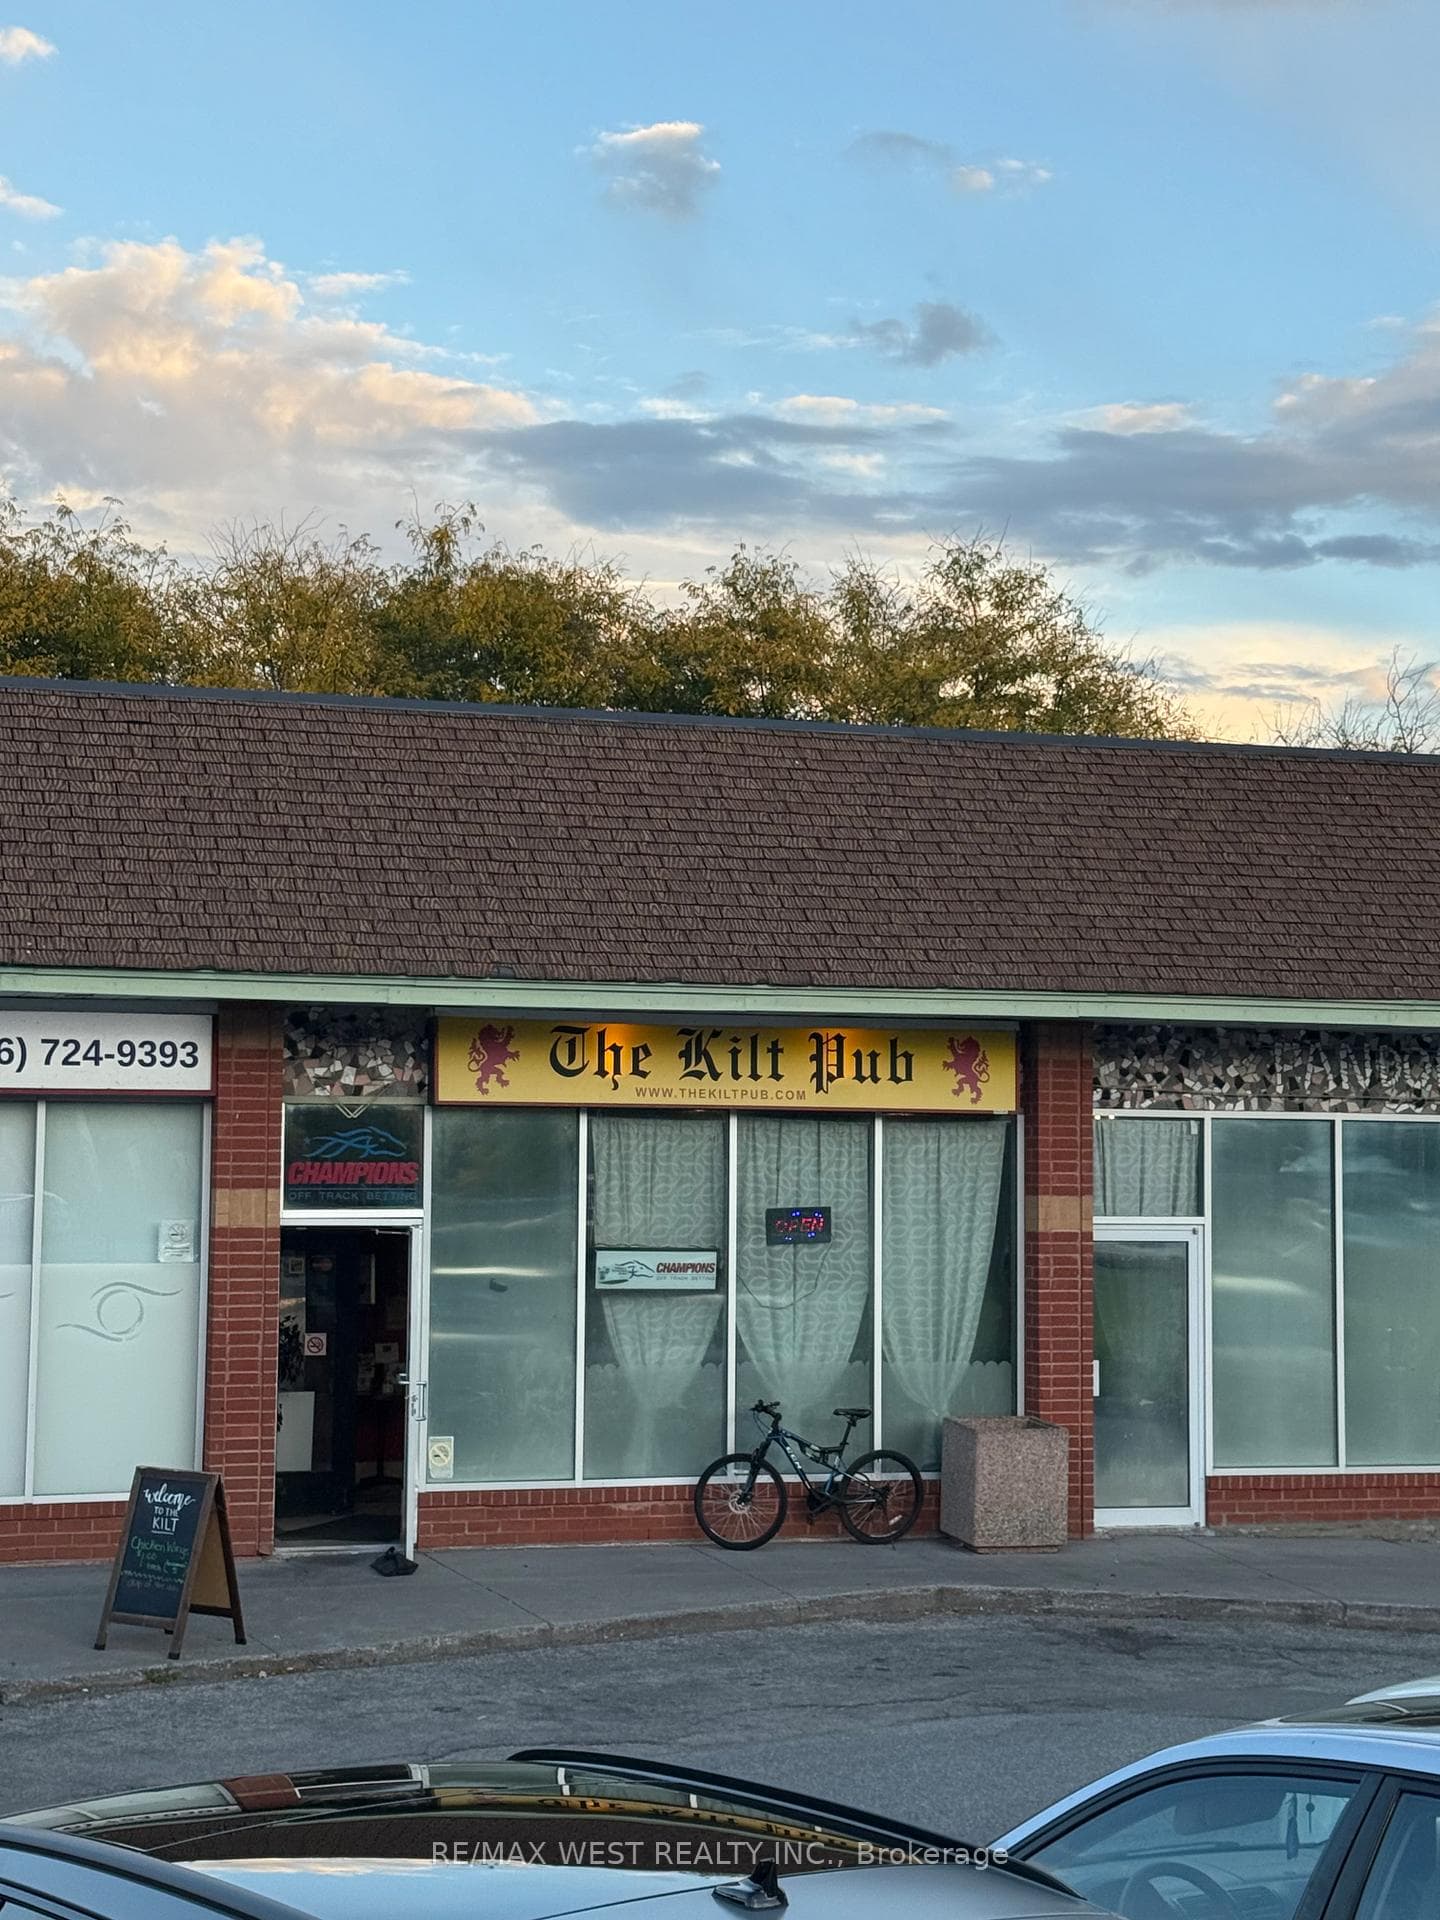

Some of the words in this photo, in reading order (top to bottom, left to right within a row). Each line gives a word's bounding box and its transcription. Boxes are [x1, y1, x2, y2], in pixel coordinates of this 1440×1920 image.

[40, 1038, 199, 1069] 724-9393
[550, 1025, 653, 1090] The
[677, 1026, 785, 1082] Kilt
[808, 1031, 915, 1094] Pub
[635, 1086, 807, 1101] WWW.THEKILTPUB.COM
[287, 1161, 419, 1185] CHAMPIONS
[288, 1190, 312, 1201] OFF
[320, 1191, 359, 1201] TRACK
[656, 1262, 716, 1274] CHAMPIONS
[154, 1506, 165, 1516] TO
[165, 1506, 179, 1518] THE
[152, 1517, 180, 1532] KILT
